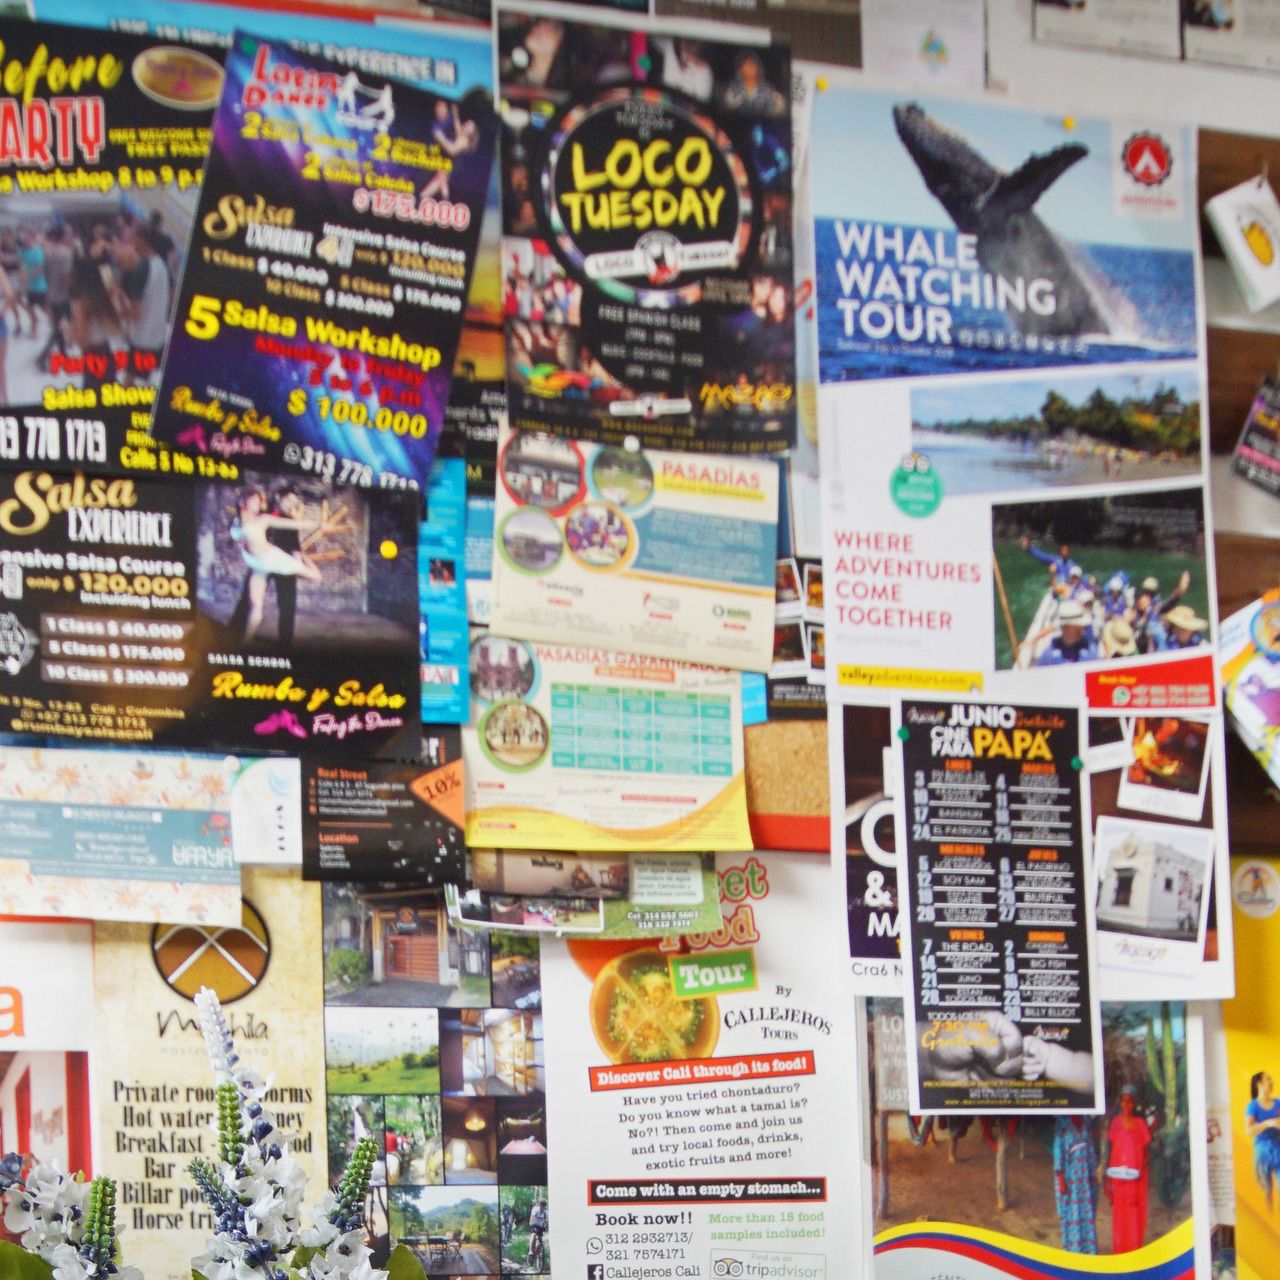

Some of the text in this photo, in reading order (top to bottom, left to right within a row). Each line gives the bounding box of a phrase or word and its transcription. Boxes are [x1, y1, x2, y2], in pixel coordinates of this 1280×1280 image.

[570, 136, 714, 192] LOCO
[560, 186, 726, 234] TUESDAY
[833, 218, 980, 271] WHALE
[836, 257, 1057, 316] WATCHING
[185, 295, 441, 372] 5 Salsa Workshop
[837, 299, 954, 344] TOUR
[288, 388, 428, 439] $ 100.000
[834, 528, 915, 554] WHERE
[835, 555, 983, 585] ADVENTURES
[836, 579, 903, 603] COME
[836, 604, 954, 632] TOGETHER
[948, 704, 1017, 729] JUNIO
[930, 725, 969, 741] CINE
[973, 727, 1053, 761] PAPÁ
[679, 963, 747, 989] Tour
[775, 985, 792, 997] By
[724, 1006, 833, 1035] CALLEJEROS
[597, 1057, 807, 1086] Discover Cali through its food!
[113, 1080, 179, 1103] Private
[622, 1082, 801, 1107] Have you tried chontaduro?
[123, 1106, 214, 1128] Hot water
[116, 1131, 202, 1153] Breakfast
[144, 1157, 175, 1179] Bar
[122, 1182, 172, 1204] Billar
[596, 1181, 821, 1200] Come with an empty stomach...
[133, 1208, 183, 1230] Horse
[595, 1212, 693, 1226] Book now!!
[708, 1211, 825, 1224] More than 15 food
[605, 1233, 629, 1244] 312
[710, 1228, 826, 1242] samples included!
[605, 1248, 686, 1261] 321 7574171
[606, 1264, 701, 1280] Callejeros Cali
[746, 1262, 819, 1279] tripadvisor
